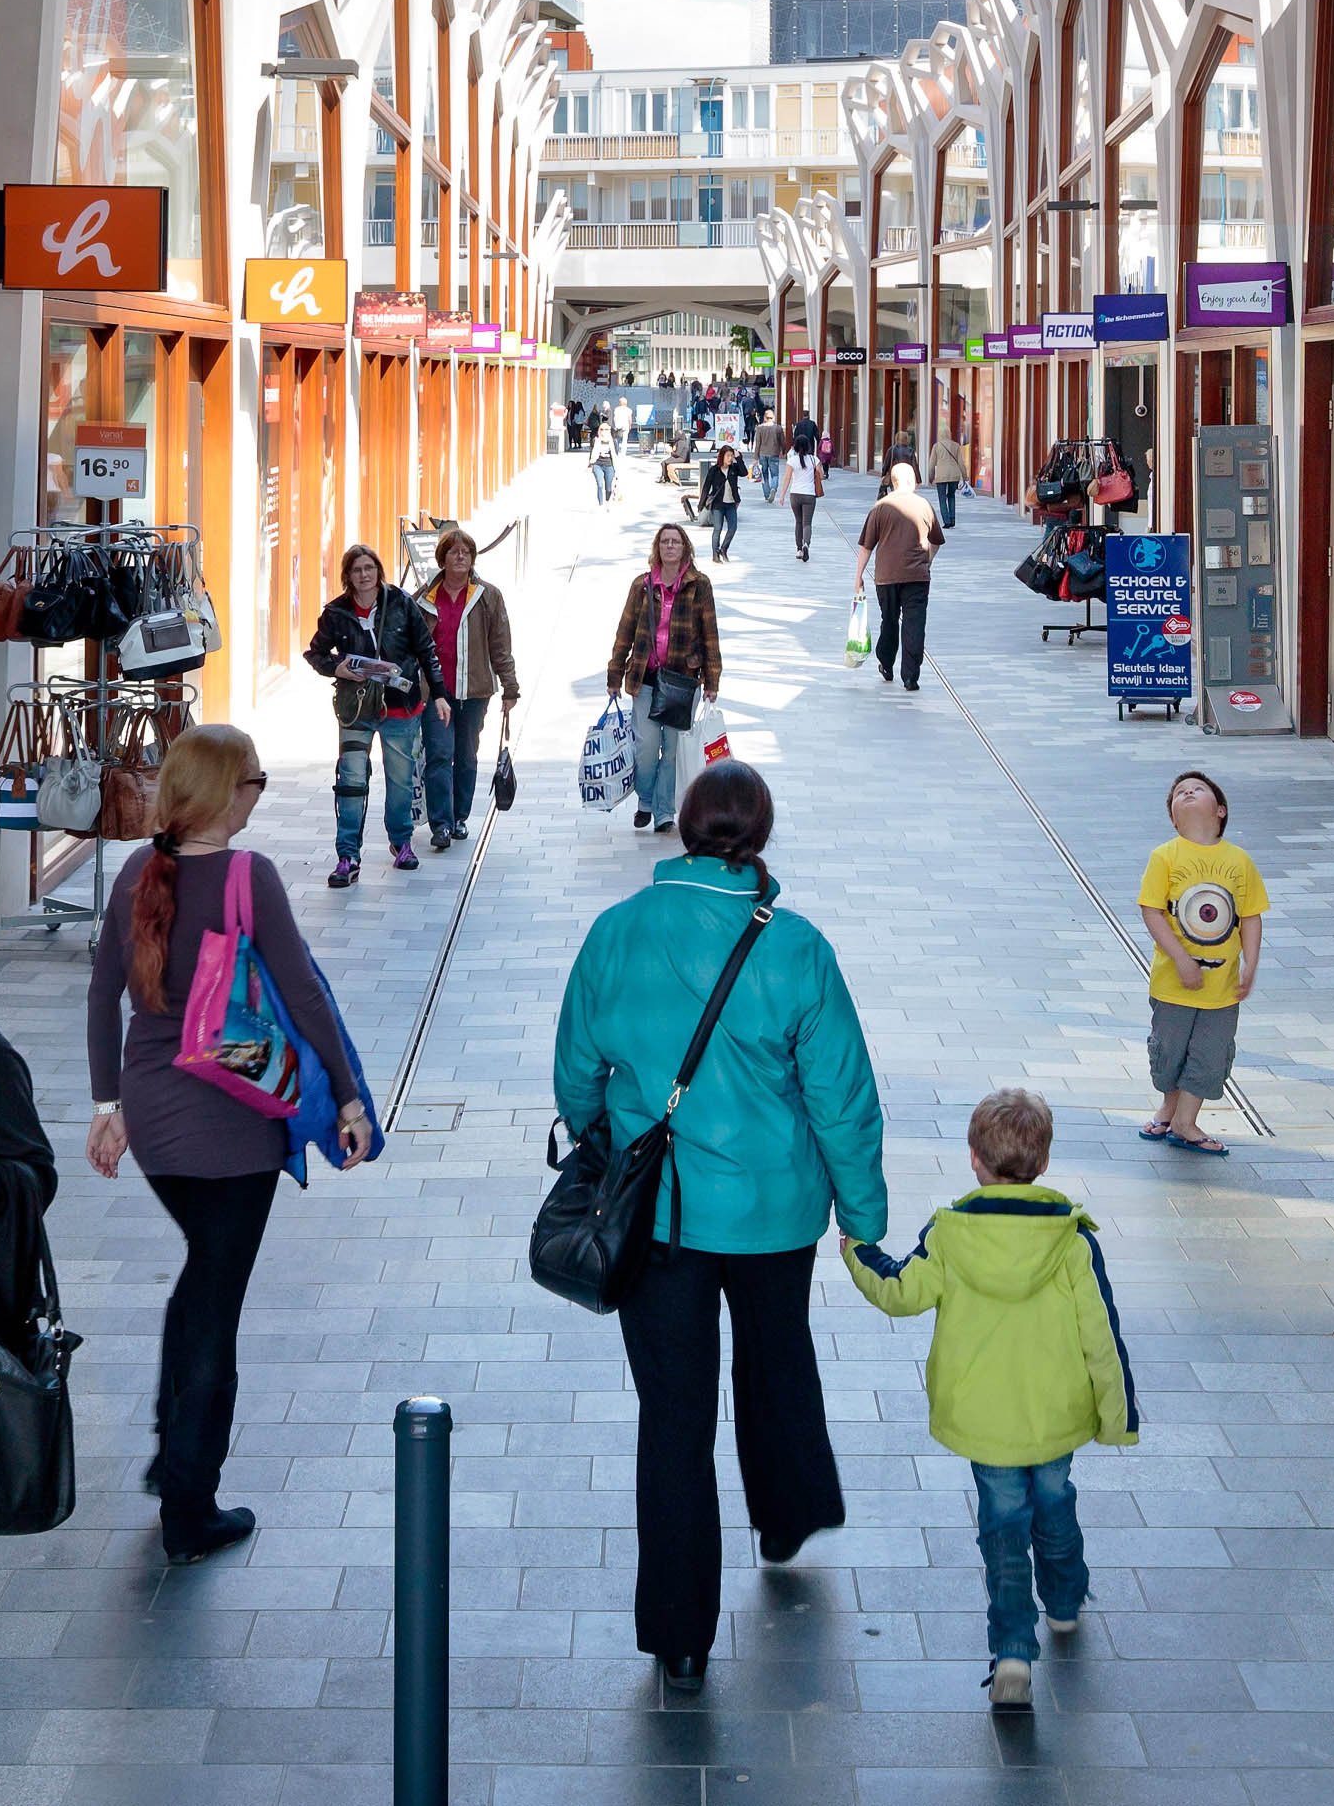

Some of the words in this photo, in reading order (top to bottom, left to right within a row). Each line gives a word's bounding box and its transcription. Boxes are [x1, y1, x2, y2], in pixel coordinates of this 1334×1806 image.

[1201, 292, 1224, 307] Enjoy
[1226, 295, 1247, 307] your
[1249, 291, 1270, 307] day!
[361, 313, 424, 324] REMBRANDT
[1115, 311, 1165, 322] Schoenmaker
[1045, 324, 1093, 338] ACTION
[837, 352, 864, 360] ecco
[80, 458, 130, 478] 16.90
[1109, 576, 1170, 587] SCHOEN
[1175, 576, 1187, 587] &
[1114, 590, 1183, 601] SLEUTEL
[1117, 604, 1181, 615] SERVICE
[1113, 663, 1155, 673] Sleutels
[1159, 664, 1186, 673] klaar
[1111, 675, 1142, 686] terwijl
[1145, 677, 1153, 685] u
[1156, 676, 1189, 685] wacht
[584, 752, 626, 781] ACTION
